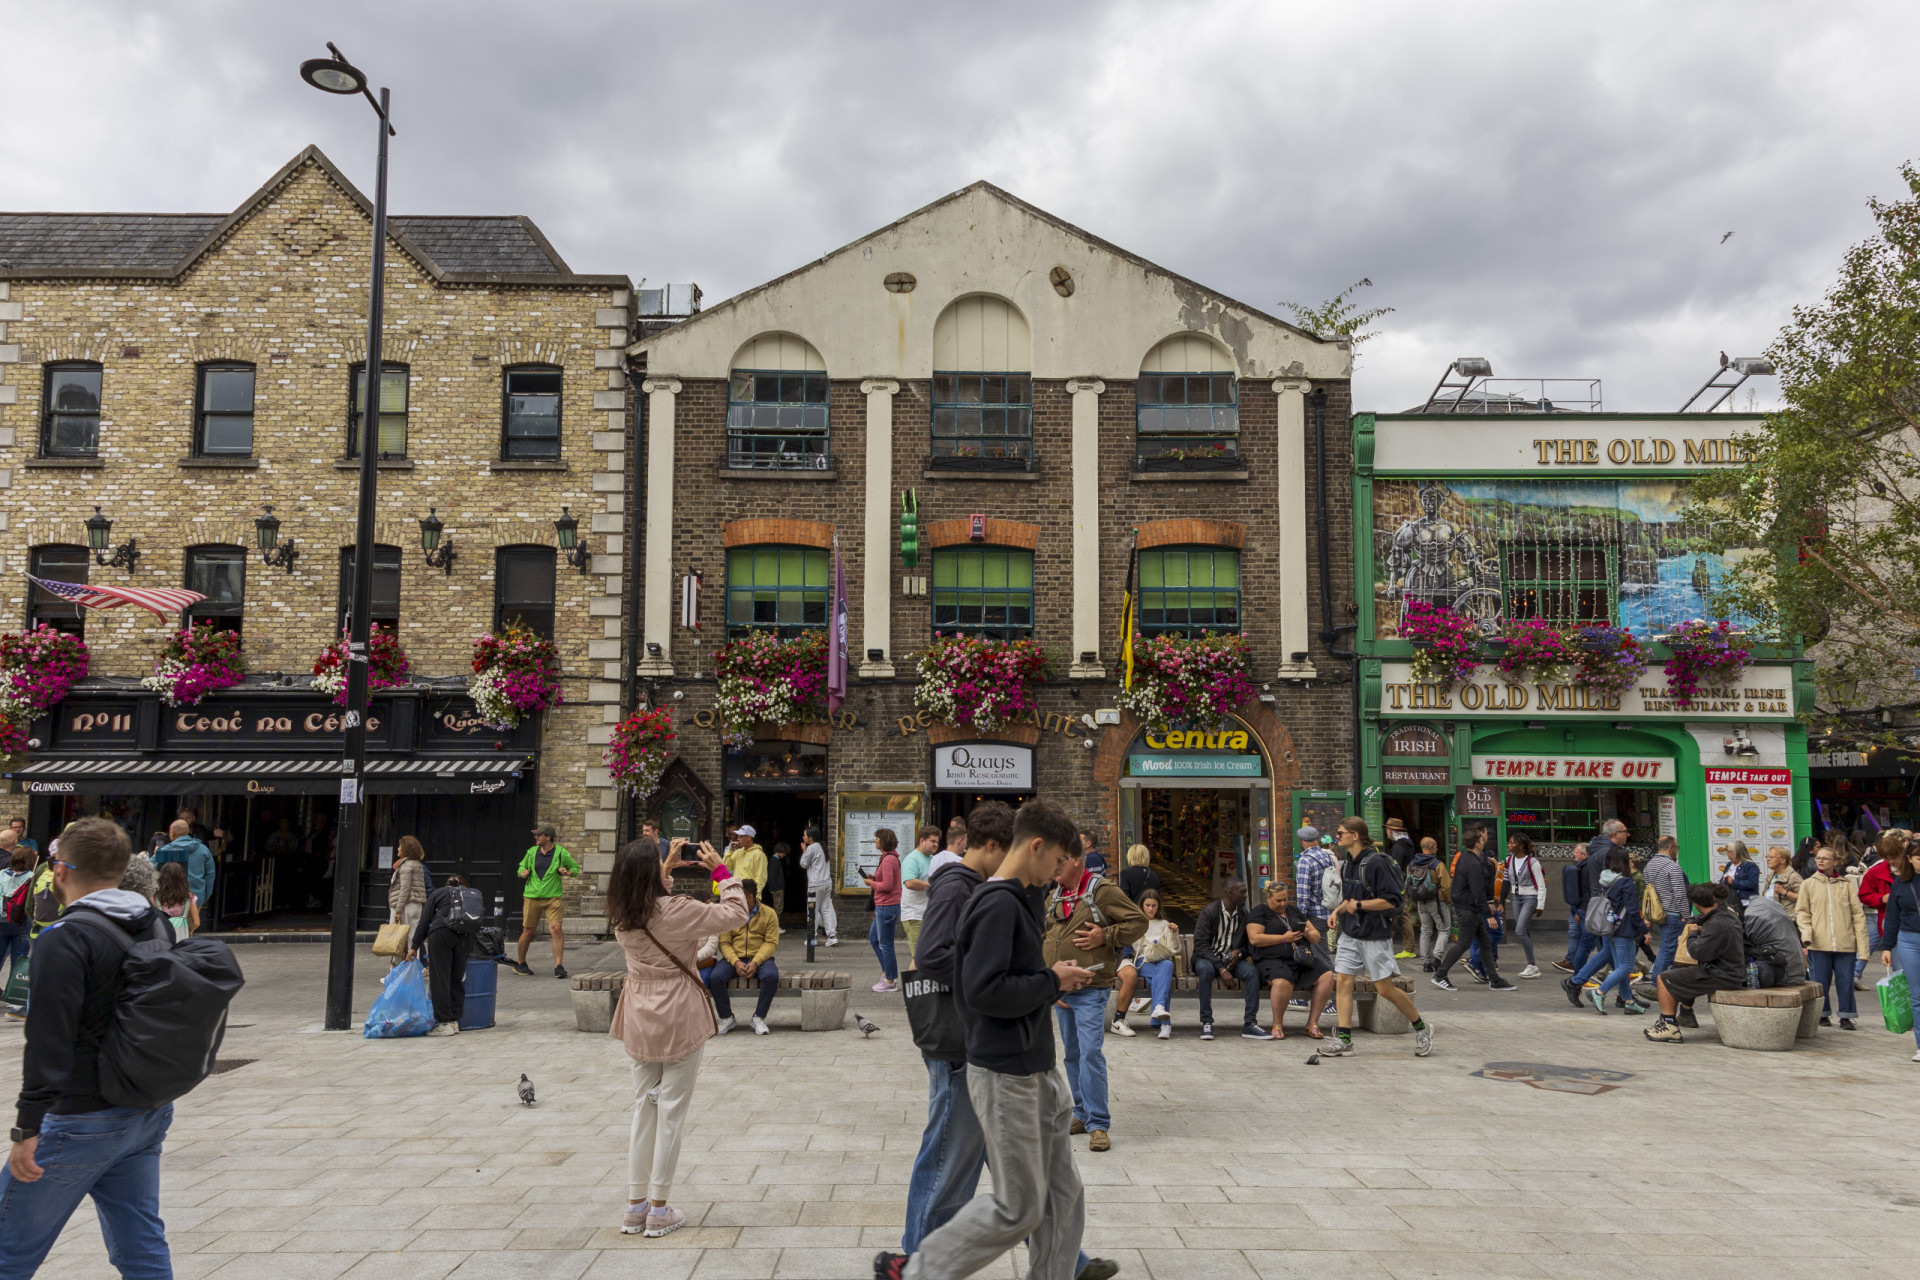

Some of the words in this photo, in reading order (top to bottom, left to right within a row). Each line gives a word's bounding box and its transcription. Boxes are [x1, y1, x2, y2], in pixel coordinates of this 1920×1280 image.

[1533, 438, 1598, 463] THE
[1607, 438, 1676, 463] OLD
[1386, 683, 1453, 709] THE
[1460, 683, 1529, 710] OLD
[1744, 687, 1786, 699] IRISH
[1744, 701, 1754, 712] &
[1758, 701, 1788, 712] BAR
[443, 714, 489, 732] Quay
[1145, 724, 1249, 749] Centra
[1389, 725, 1440, 741] TRADITIONAL
[1394, 740, 1436, 752] IRISH
[952, 748, 1015, 772] Quays
[1142, 759, 1172, 771] Mood
[1174, 761, 1193, 770] 100%
[1194, 760, 1212, 770] Irish
[1213, 760, 1225, 770] Ice
[1226, 760, 1252, 770] Cream
[1485, 760, 1557, 777] TEMPLE
[1565, 760, 1614, 778] TAKE
[1622, 761, 1662, 778] OUT
[1385, 771, 1447, 780] RESTAURANT
[1709, 771, 1748, 781] TEMPLE
[1750, 774, 1769, 782] TAKE
[1771, 774, 1786, 782] OUT
[1467, 791, 1491, 801] OLD
[1468, 801, 1491, 809] MILL
[1509, 814, 1536, 822] OPEN
